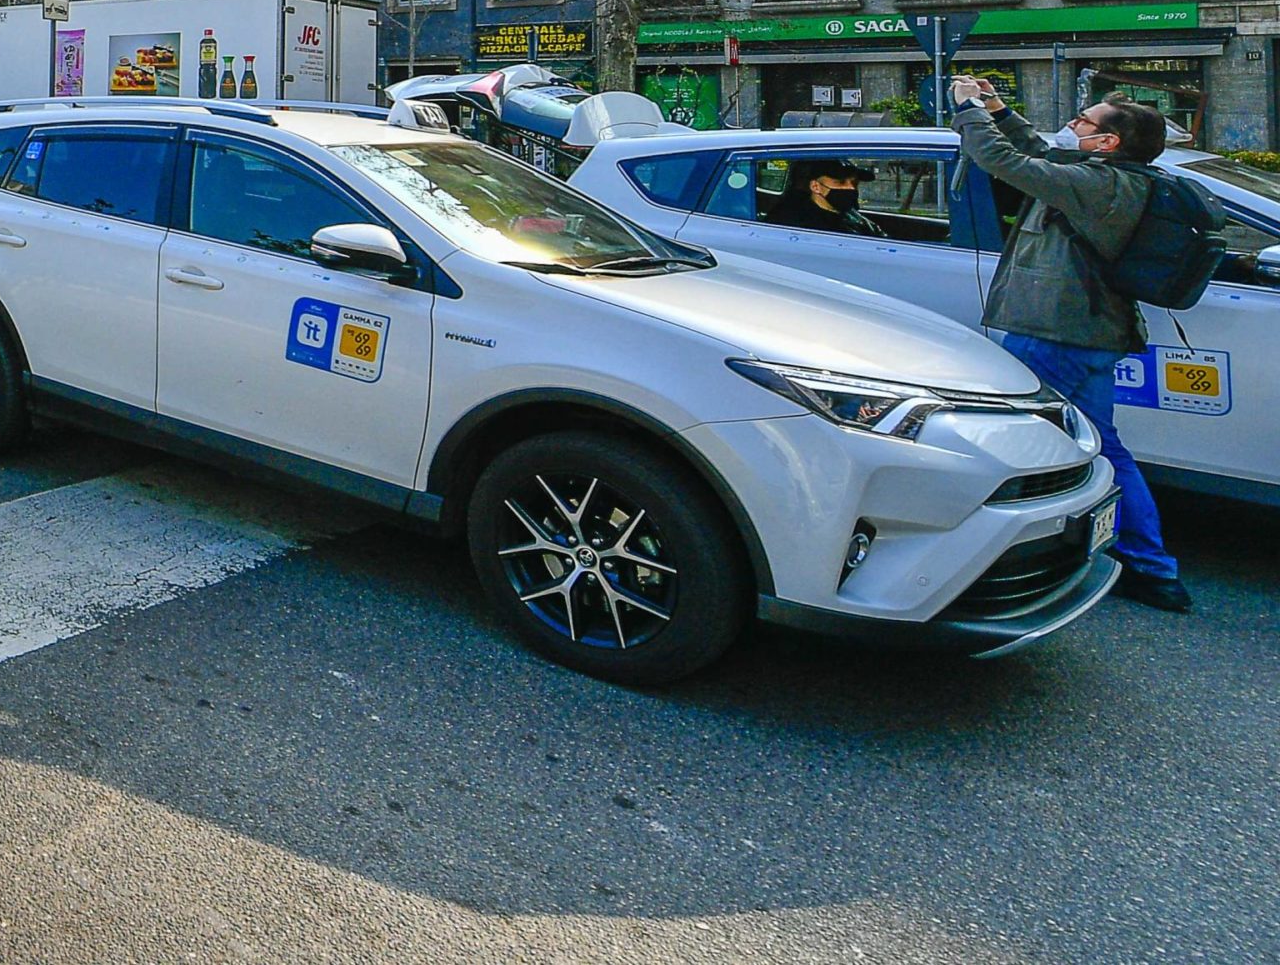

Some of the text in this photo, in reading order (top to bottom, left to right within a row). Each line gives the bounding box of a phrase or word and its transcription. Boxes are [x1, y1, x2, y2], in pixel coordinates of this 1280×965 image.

[1163, 11, 1187, 20] 1970
[854, 19, 910, 33] SAGA
[297, 25, 321, 46] JFC
[479, 35, 529, 45] TURKIS
[343, 312, 383, 328] GAMMA 62
[355, 331, 370, 345] 69
[355, 344, 372, 357] 69
[1165, 352, 1192, 360] LIMA
[1185, 369, 1207, 381] 69
[1190, 380, 1212, 392] 69
